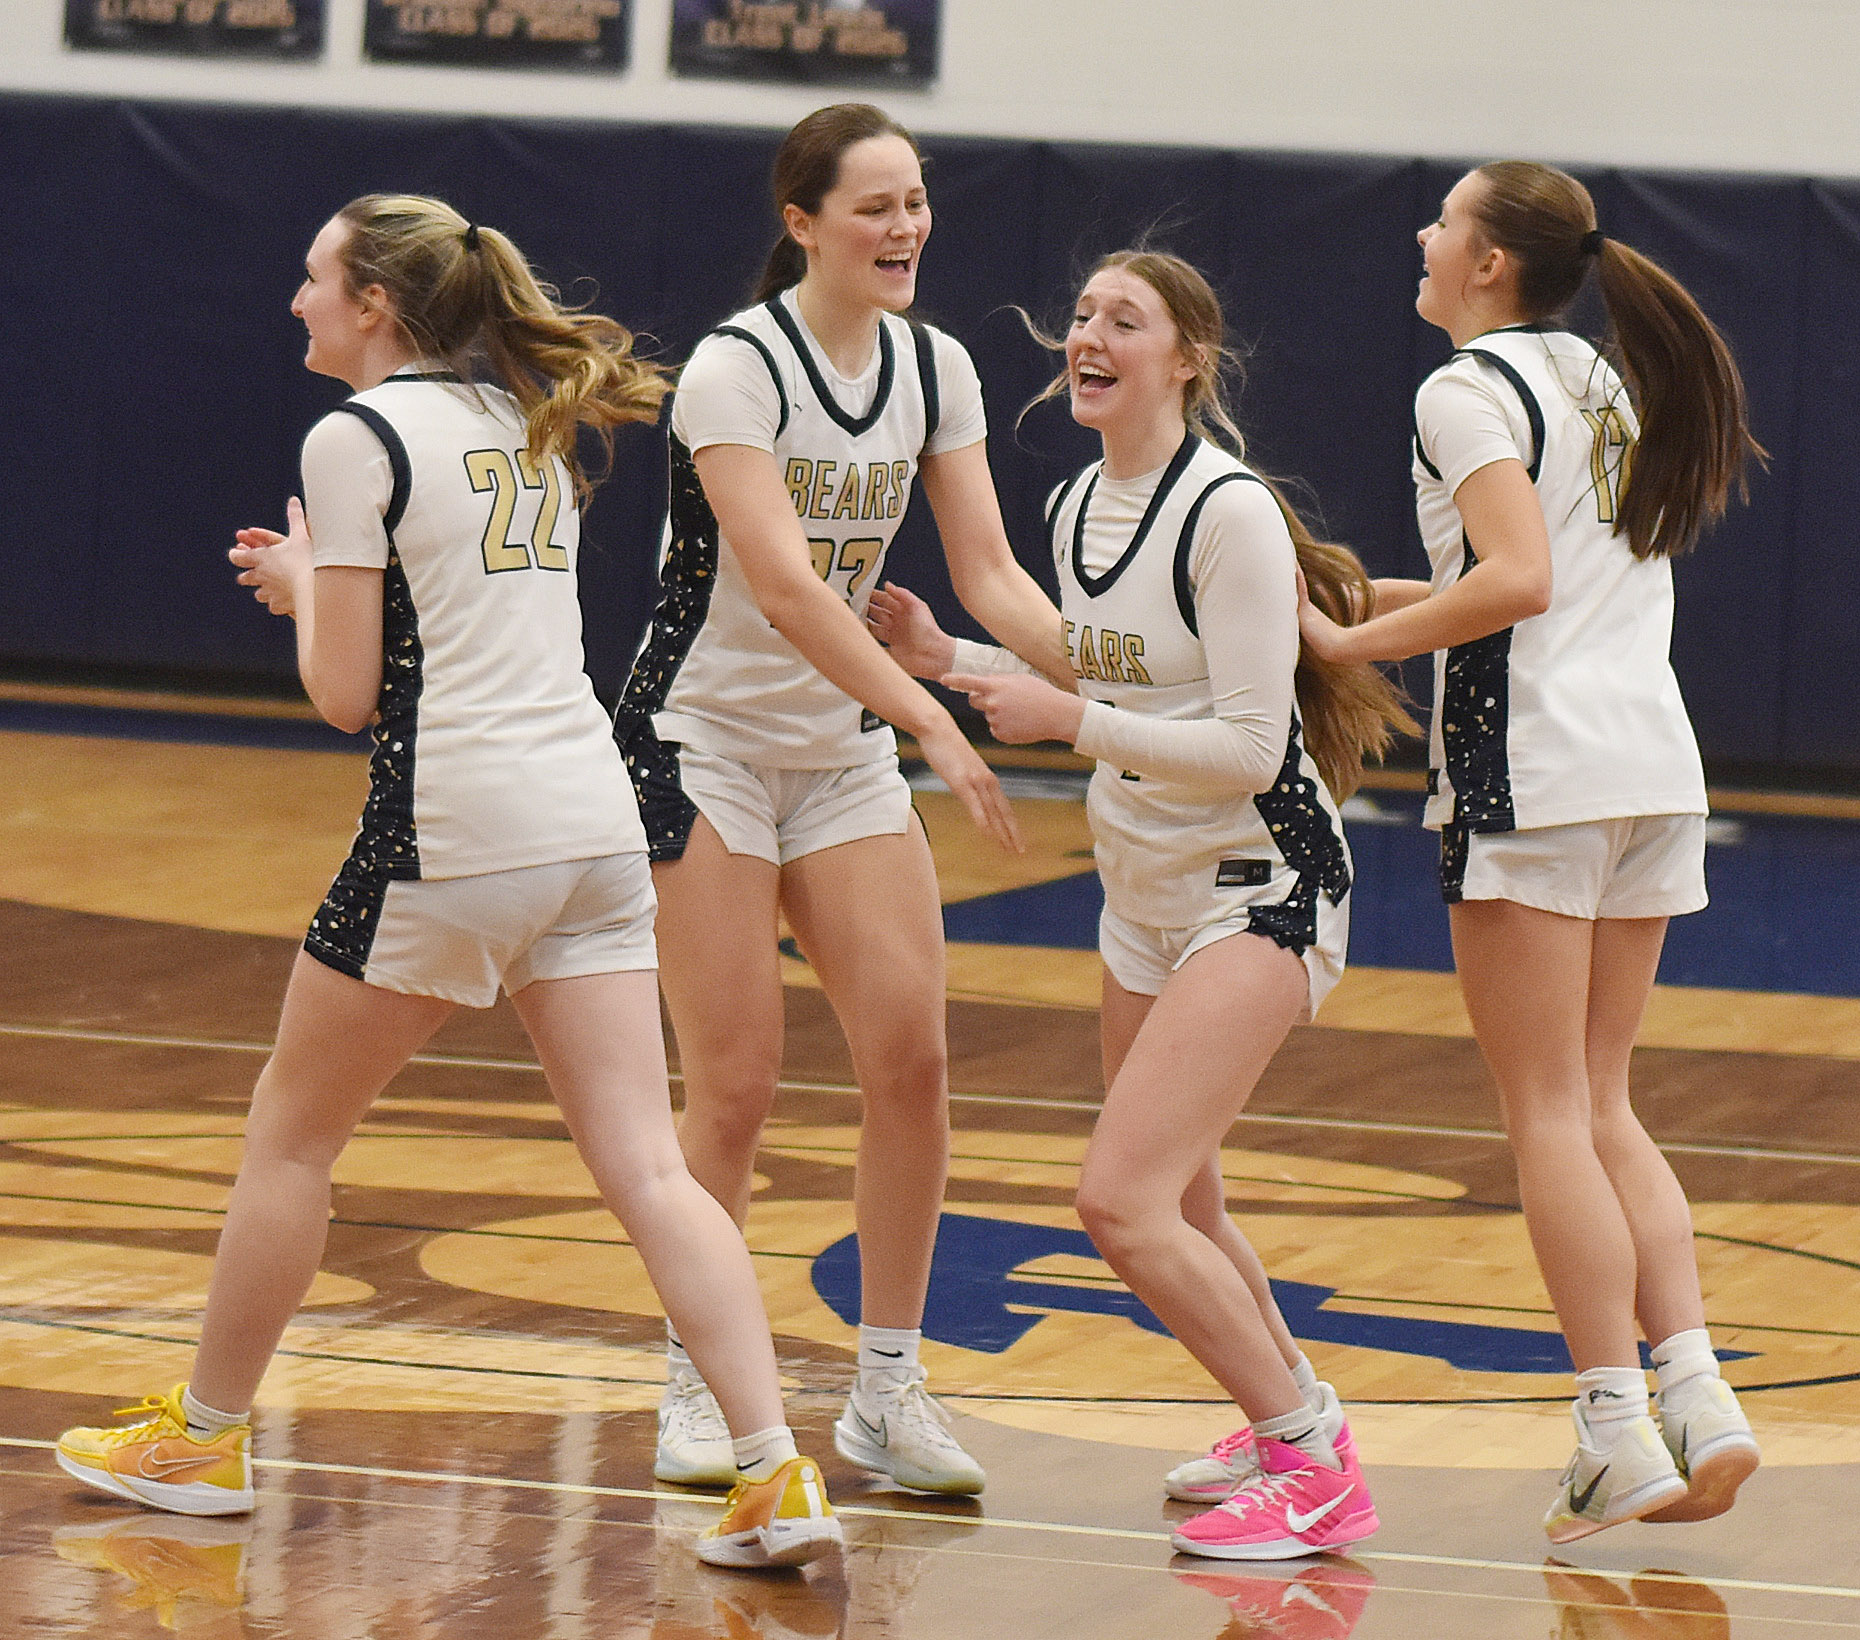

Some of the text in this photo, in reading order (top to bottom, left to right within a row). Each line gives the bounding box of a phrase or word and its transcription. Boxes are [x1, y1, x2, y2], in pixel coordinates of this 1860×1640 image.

[463, 448, 569, 575] 22
[785, 457, 909, 520] BEARS
[1062, 620, 1153, 685] EARS
